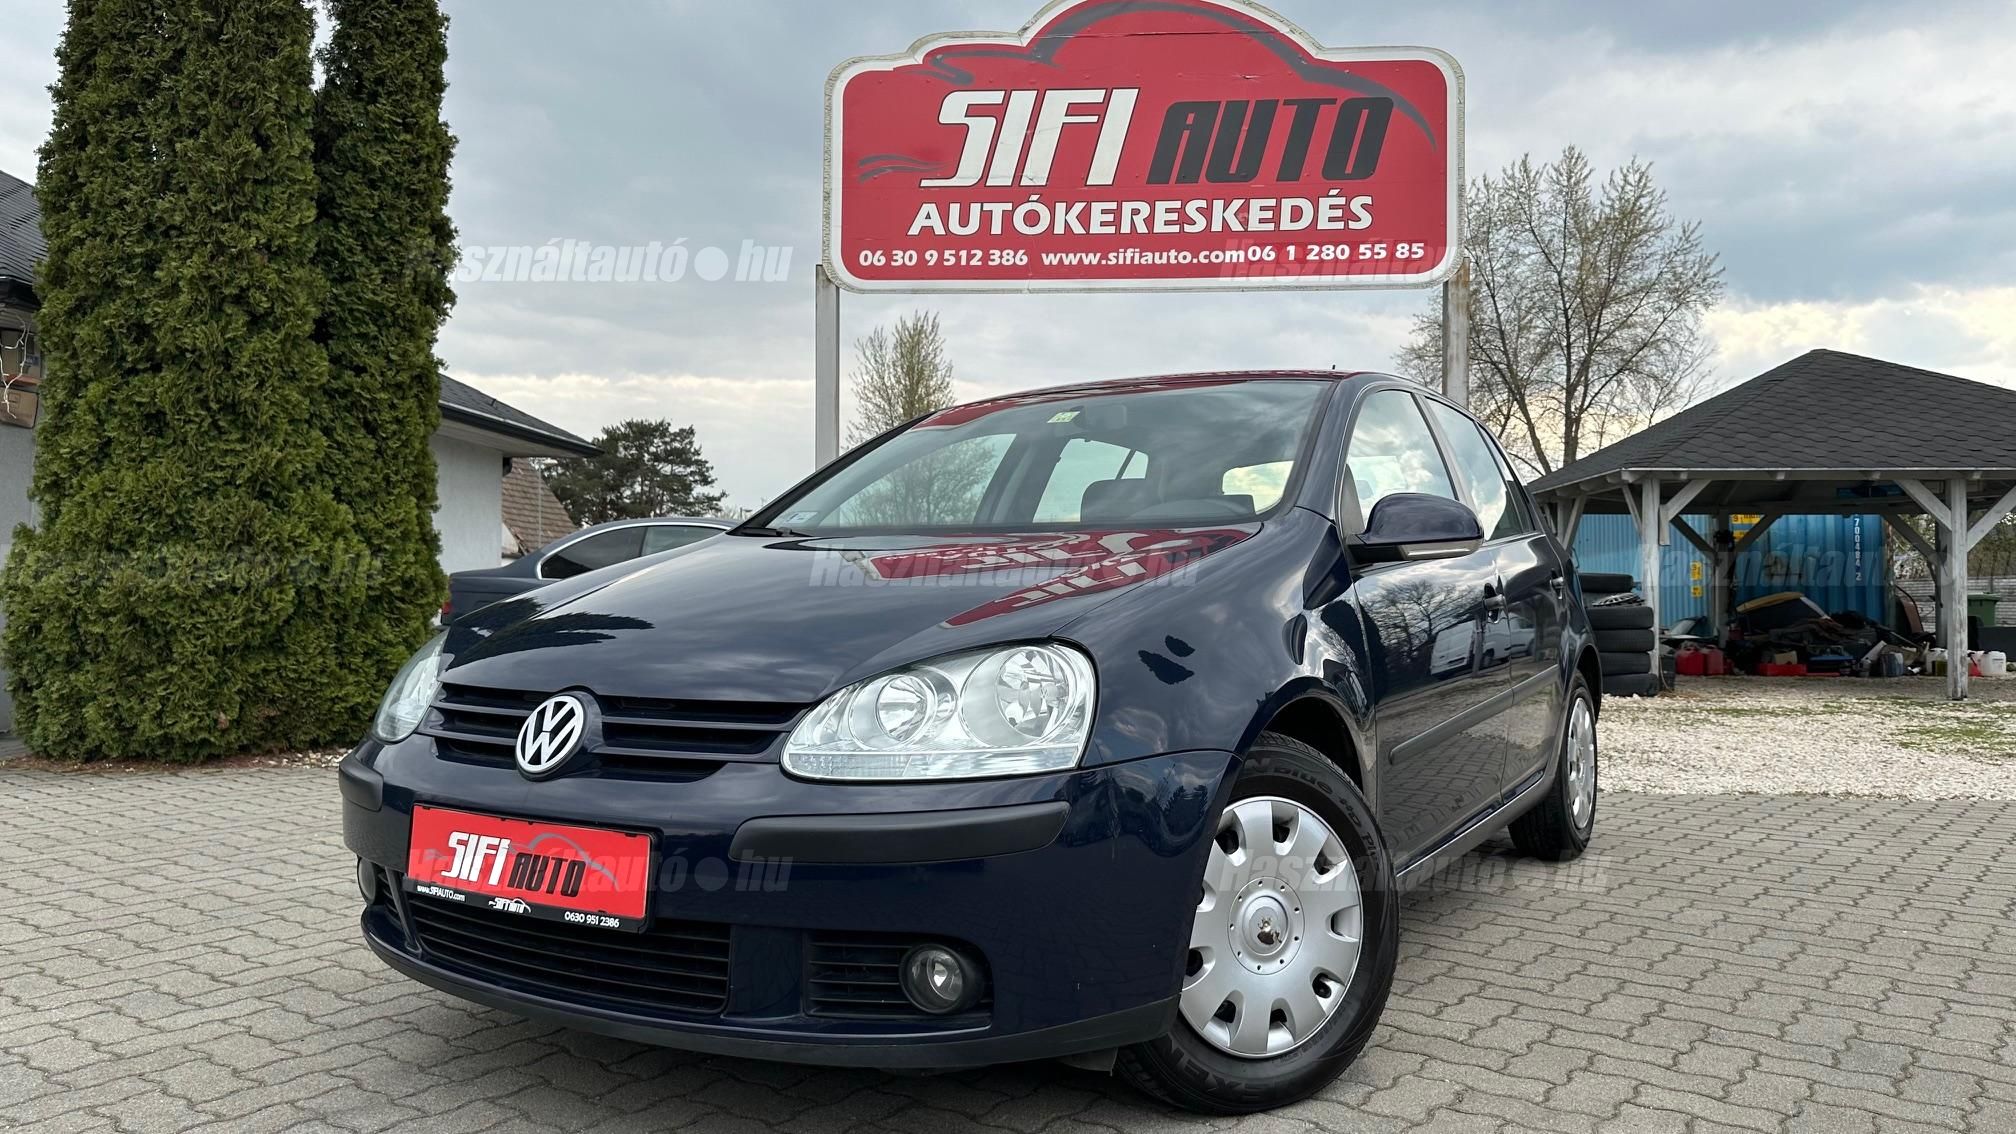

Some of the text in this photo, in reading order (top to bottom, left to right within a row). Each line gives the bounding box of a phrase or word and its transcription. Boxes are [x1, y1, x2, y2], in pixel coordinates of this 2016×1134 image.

[919, 87, 1394, 187] SIFI AUTO
[907, 189, 1374, 236] AUTÓKERESKEDÉS
[859, 249, 1028, 266] 06 30 9 512 386
[1042, 248, 1245, 266] www.sifiauto.com
[1247, 242, 1424, 261] 06 1 280 55 85
[441, 831, 587, 898] SIFI AUTO
[564, 910, 620, 928] 0630 951 2386
